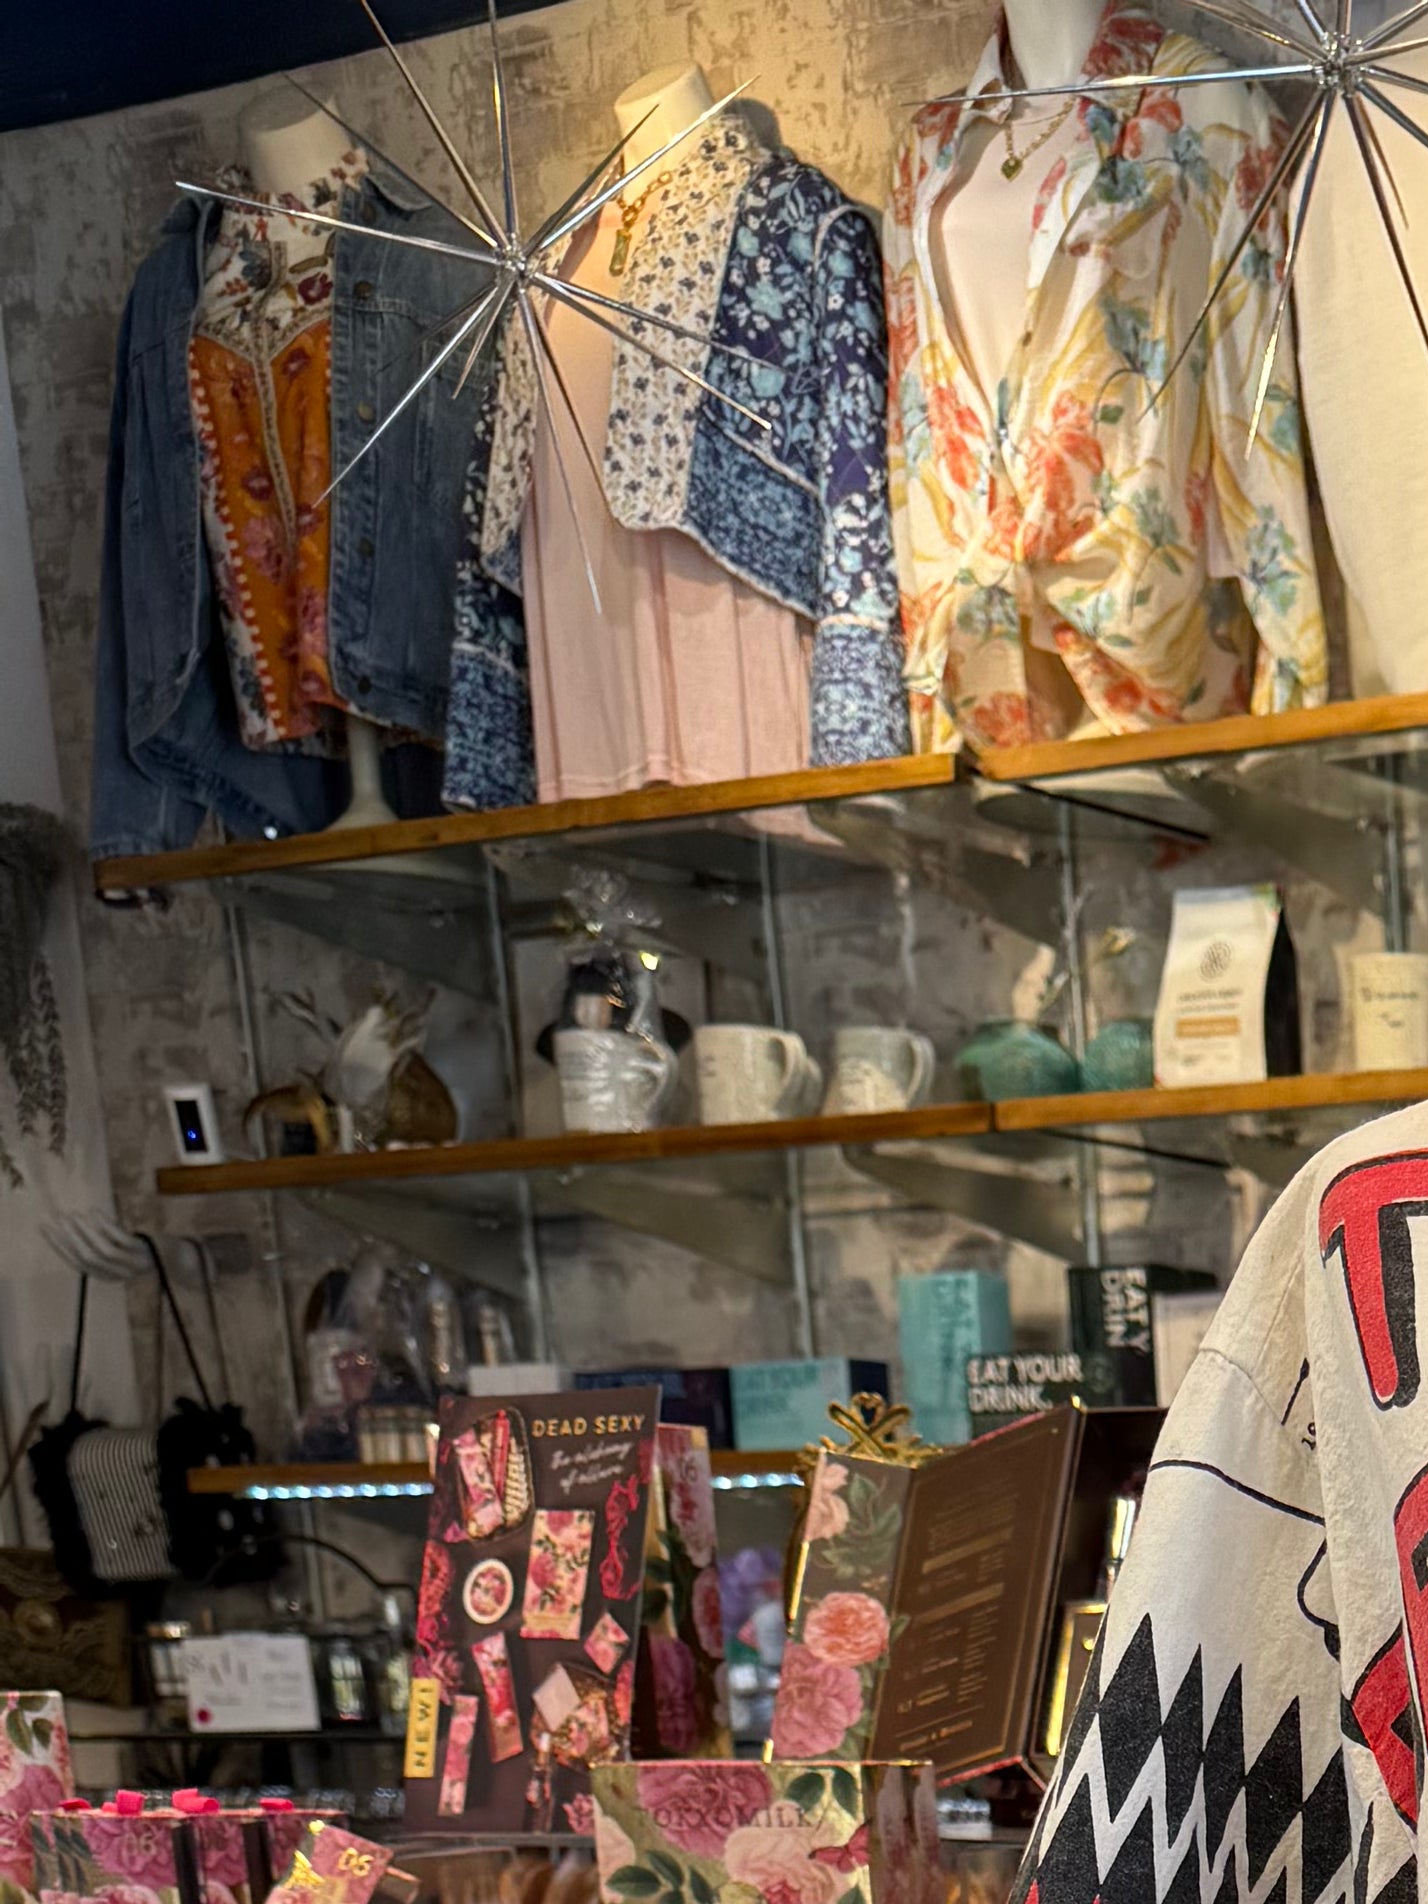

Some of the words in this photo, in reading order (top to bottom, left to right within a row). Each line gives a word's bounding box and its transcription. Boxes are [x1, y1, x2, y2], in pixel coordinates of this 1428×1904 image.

[967, 1357, 1012, 1386] EAT
[1013, 1352, 1083, 1385] YOUR
[531, 1416, 588, 1438] DEAD
[593, 1413, 646, 1435] SEXY
